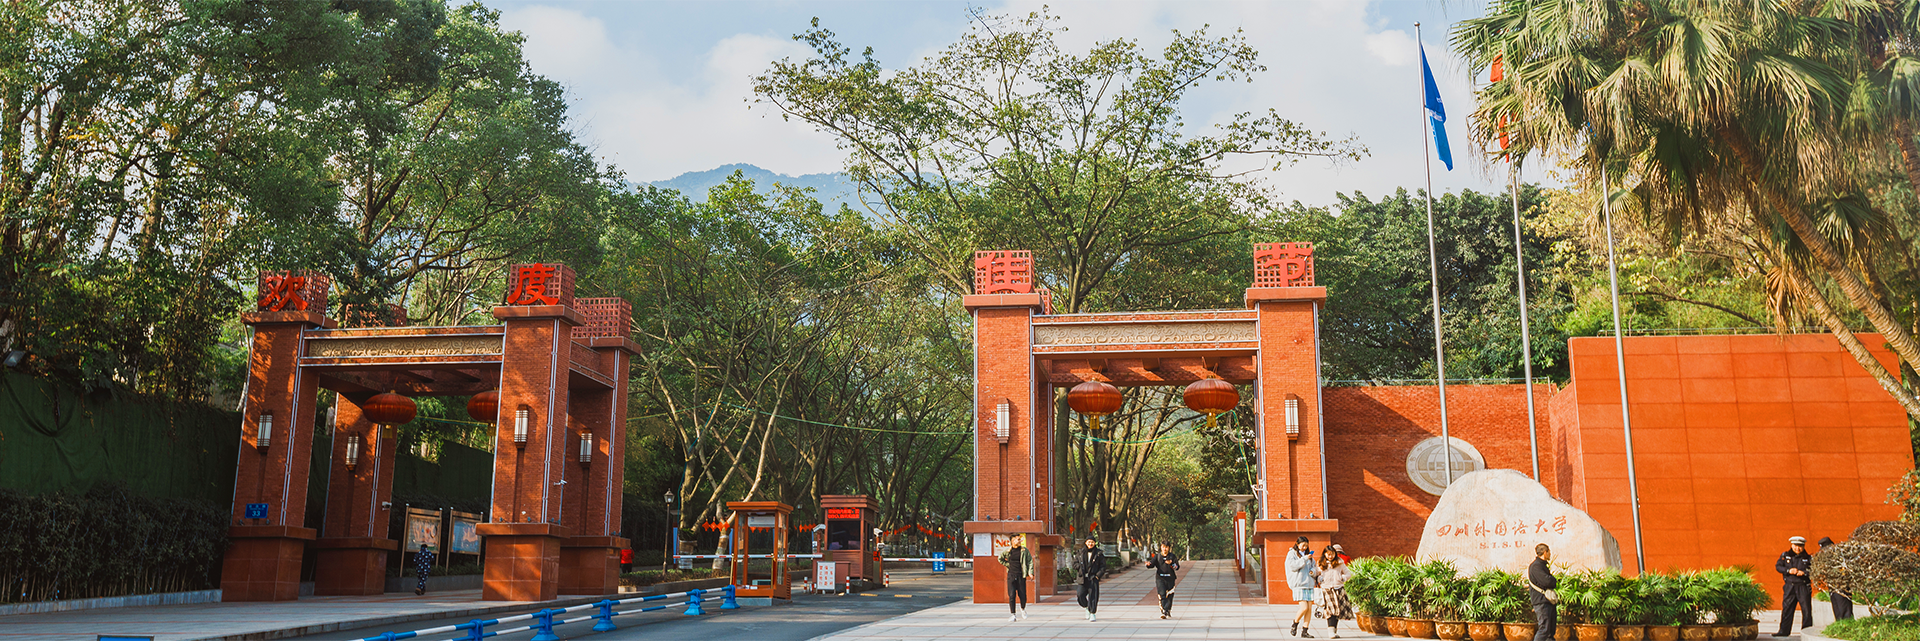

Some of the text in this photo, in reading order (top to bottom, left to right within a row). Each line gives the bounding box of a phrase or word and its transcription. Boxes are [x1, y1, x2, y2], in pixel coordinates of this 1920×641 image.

[508, 263, 559, 306] 度
[975, 250, 1032, 294] 佳
[1254, 242, 1313, 287] 节
[257, 270, 308, 312] 欢
[1436, 515, 1567, 538] 四川外国语大学
